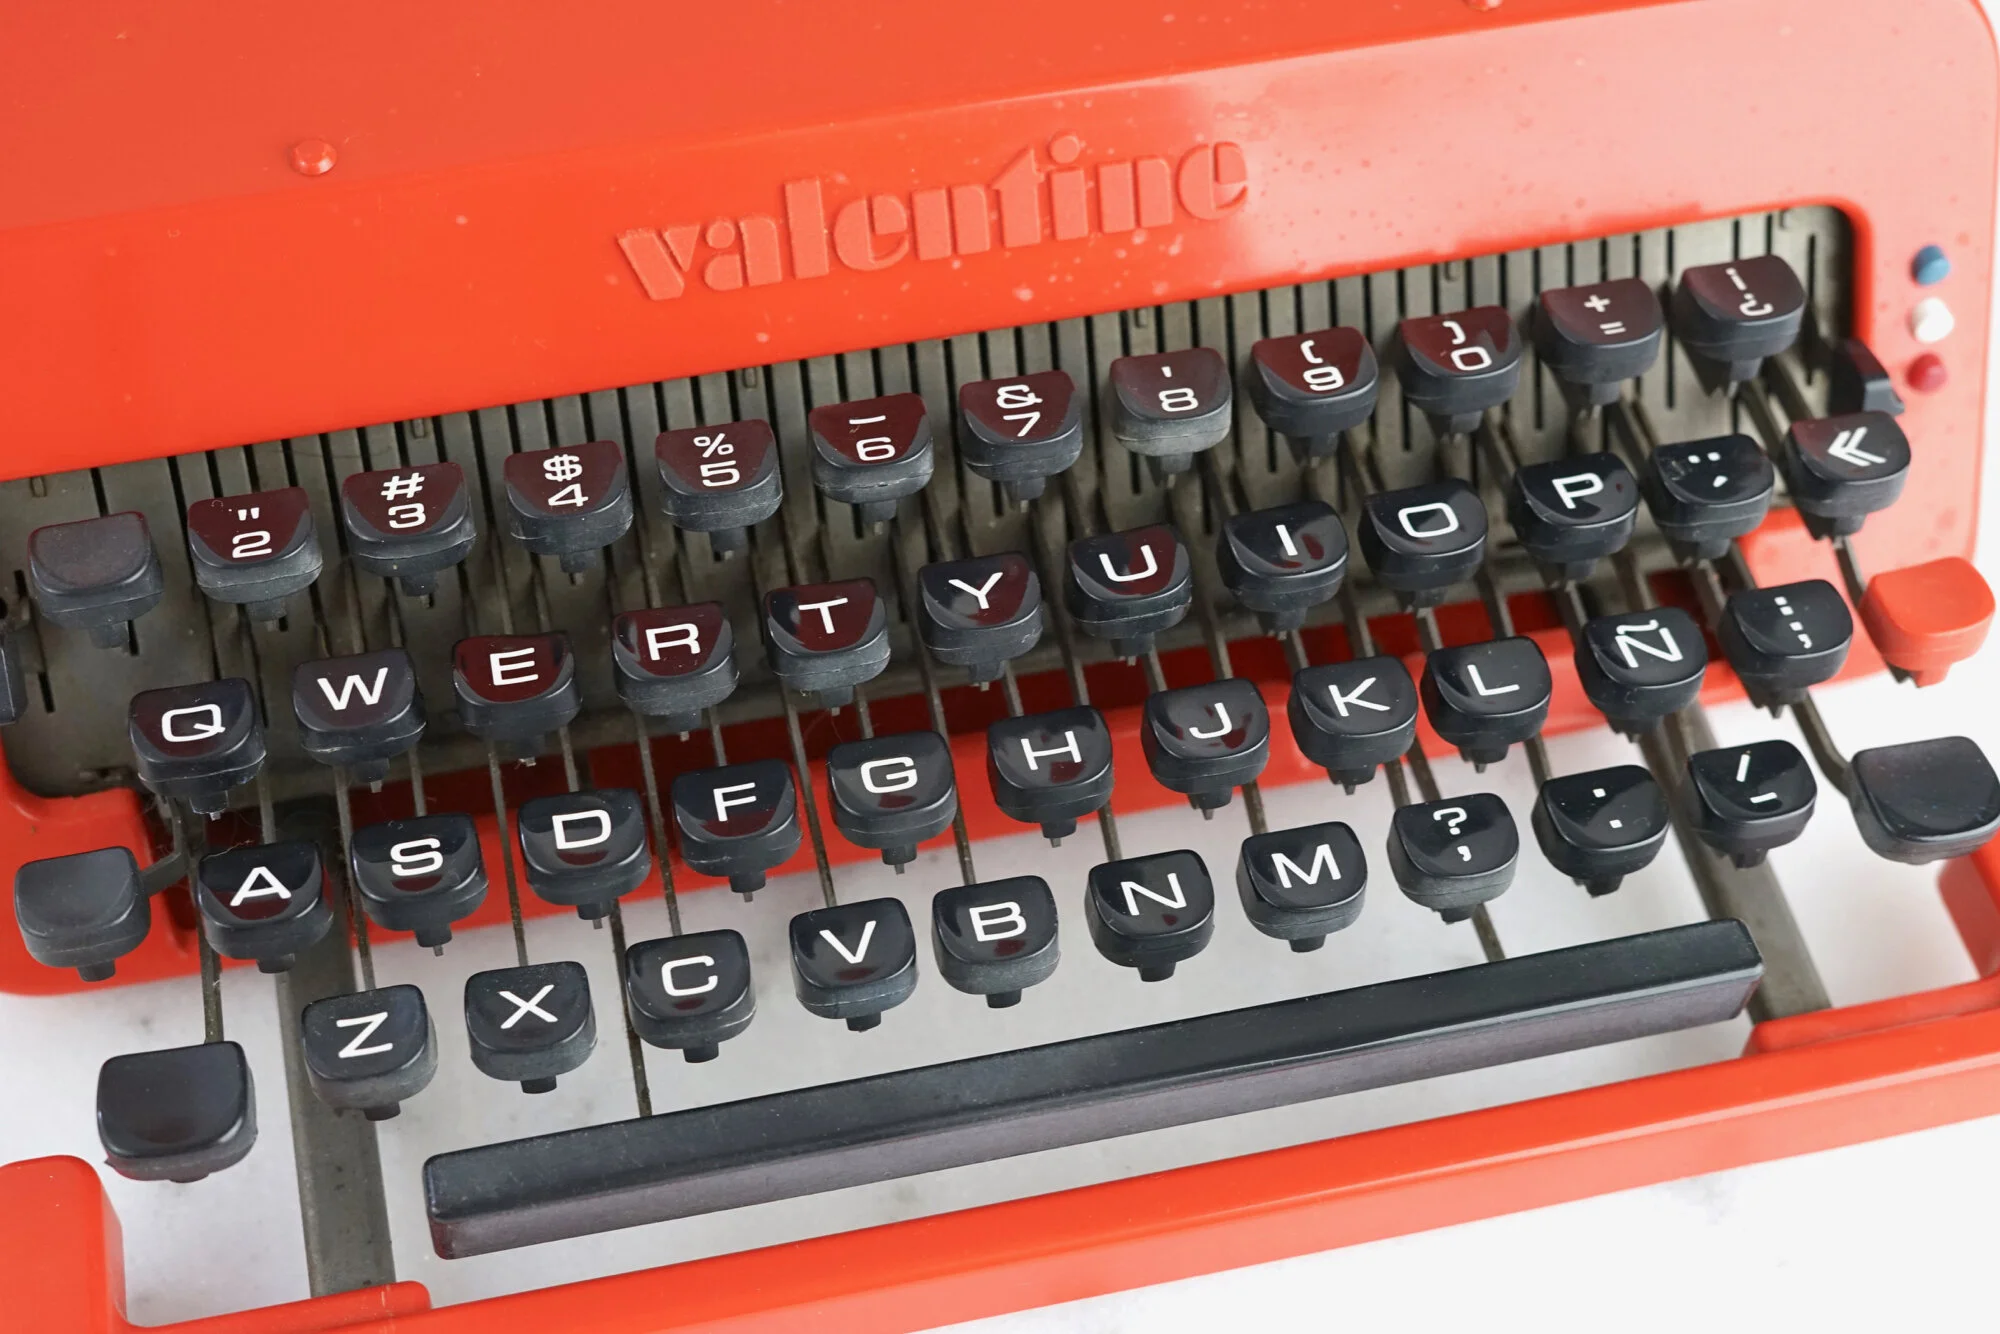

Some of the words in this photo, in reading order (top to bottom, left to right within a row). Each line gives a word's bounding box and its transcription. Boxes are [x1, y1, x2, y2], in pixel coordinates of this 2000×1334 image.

[616, 132, 1248, 302] valentine
[1583, 295, 1610, 313] +
[996, 384, 1043, 409] &
[1302, 365, 1345, 392] 9
[1158, 387, 1199, 413] 8
[1002, 413, 1038, 438] 7
[693, 432, 736, 460] %
[855, 436, 896, 461] 6
[380, 472, 425, 501] #
[542, 453, 583, 482] $
[699, 459, 741, 488] 5
[547, 483, 589, 508] 4
[1551, 472, 1604, 509] P
[387, 503, 427, 530] 3
[1397, 502, 1459, 539] O
[231, 530, 273, 559] 2
[1275, 524, 1299, 557] I
[1098, 544, 1158, 582] U
[948, 571, 1004, 610] Y
[797, 597, 849, 634] T
[645, 623, 701, 661] R
[1614, 619, 1684, 669] Ñ
[489, 647, 539, 686] E
[1466, 664, 1521, 697] L
[316, 667, 389, 711] W
[1327, 676, 1391, 717] K
[161, 703, 226, 743] Q
[1188, 702, 1233, 740] J
[1020, 730, 1082, 771] H
[860, 756, 918, 794] G
[713, 782, 757, 822] F
[1432, 805, 1469, 837] ?
[551, 809, 612, 850] D
[390, 837, 444, 877] S
[1270, 843, 1342, 889] M
[230, 866, 292, 907] A
[1120, 872, 1188, 916] N
[968, 901, 1027, 943] B
[819, 920, 877, 965] V
[661, 955, 719, 997] C
[498, 984, 559, 1030] X
[336, 1011, 394, 1059] Z
